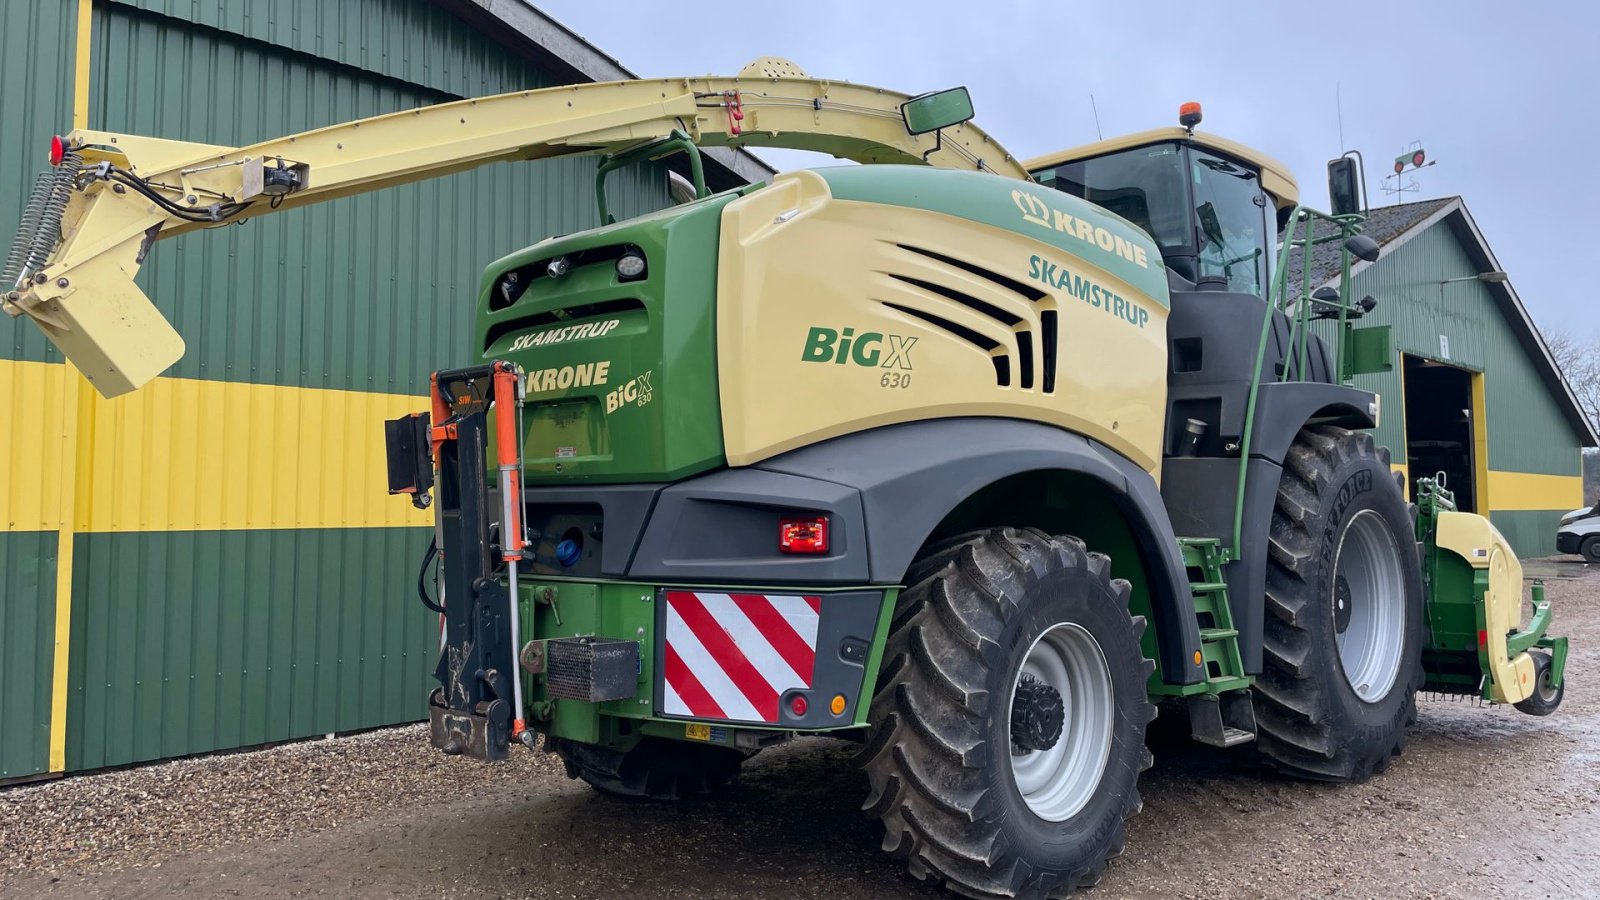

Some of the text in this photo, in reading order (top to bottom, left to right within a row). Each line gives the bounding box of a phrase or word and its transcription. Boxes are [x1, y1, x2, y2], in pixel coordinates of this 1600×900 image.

[1053, 210, 1149, 269] KRONE
[1028, 254, 1149, 329] SKAMSTRUP
[508, 319, 620, 352] SKAMSTRUP
[526, 360, 611, 393] KRONE
[880, 372, 911, 389] 630
[637, 392, 652, 407] 630
